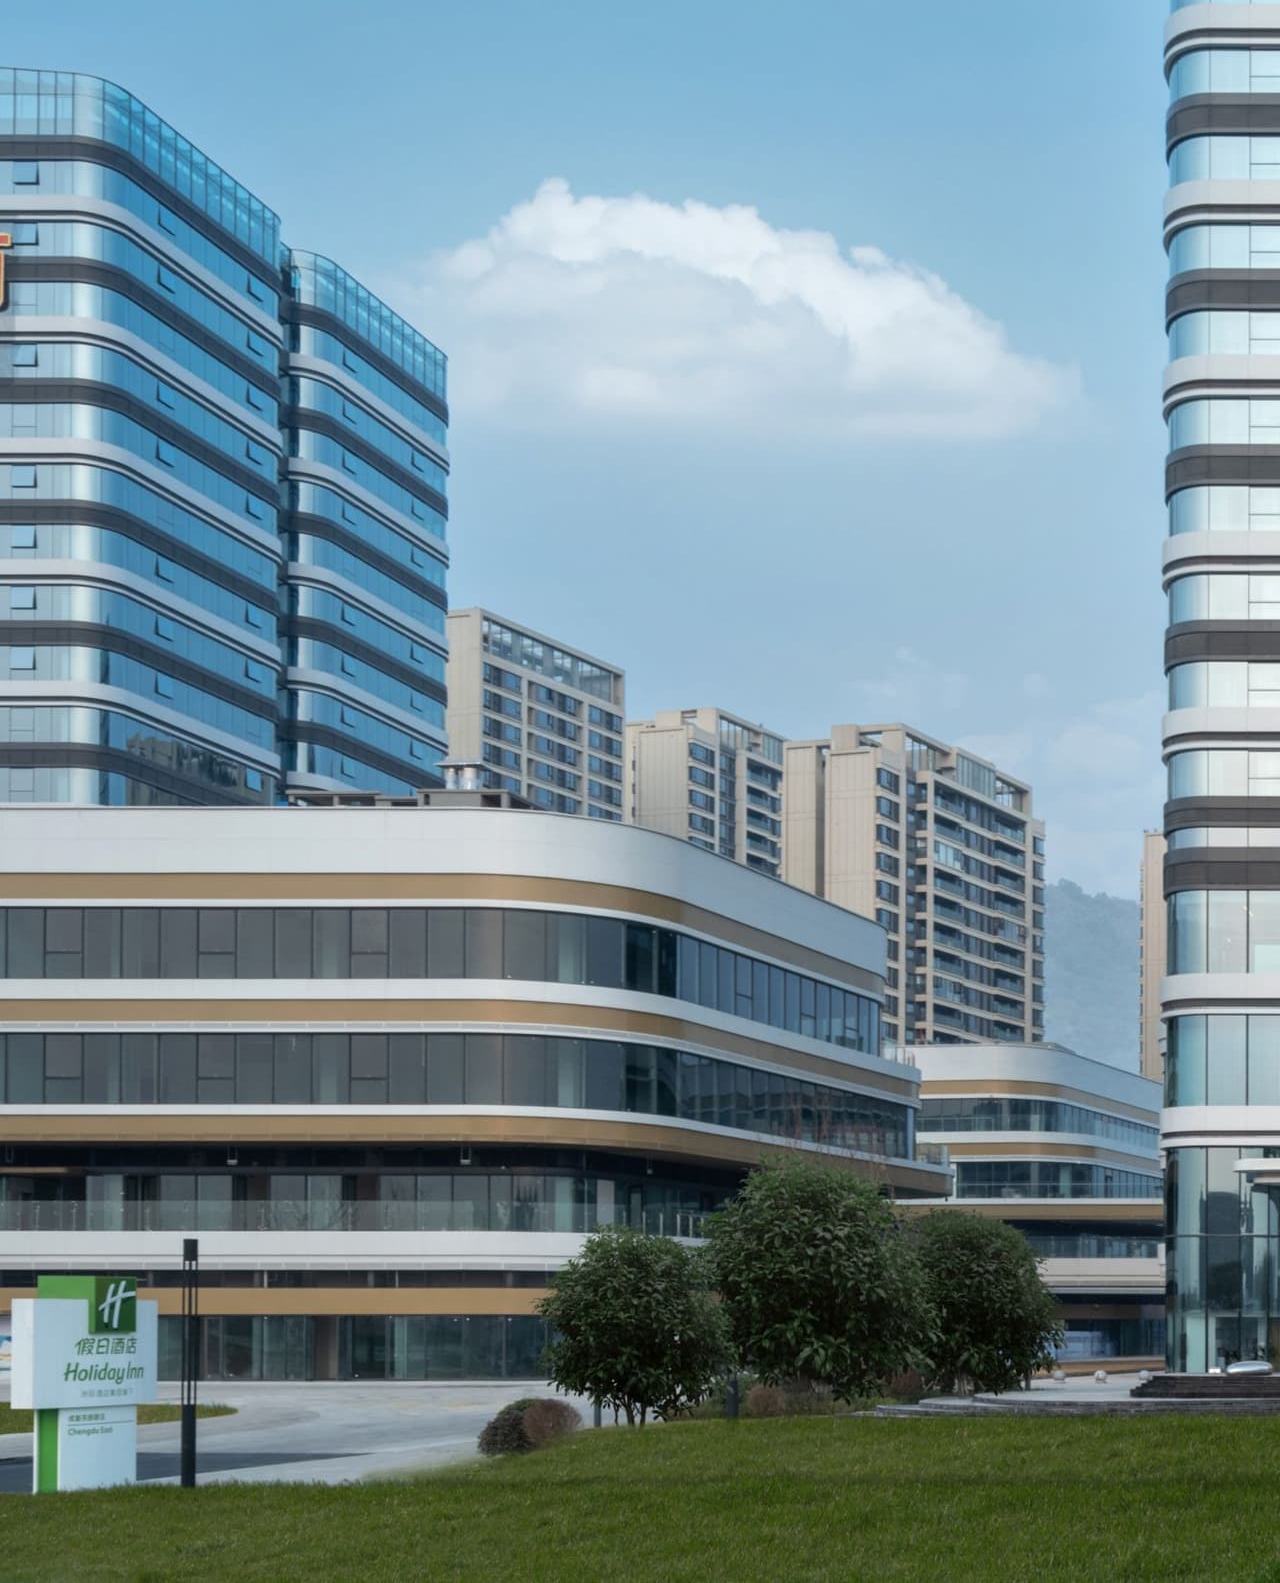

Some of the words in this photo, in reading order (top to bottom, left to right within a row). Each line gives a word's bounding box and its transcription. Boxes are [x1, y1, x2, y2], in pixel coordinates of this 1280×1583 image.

[75, 1337, 137, 1355] 假日酒店
[64, 1362, 125, 1384] Holiday
[126, 1361, 144, 1379] Inn
